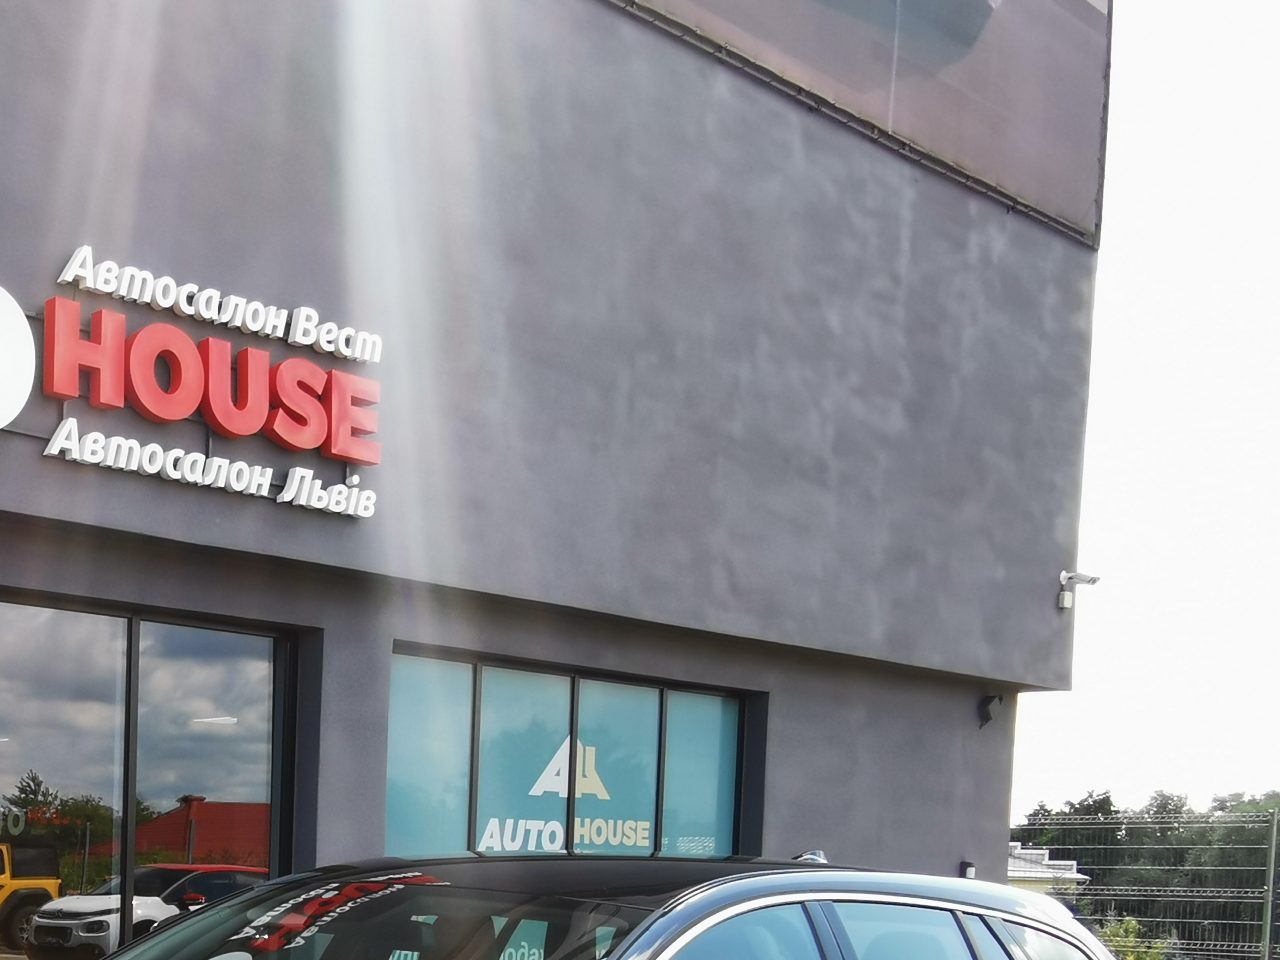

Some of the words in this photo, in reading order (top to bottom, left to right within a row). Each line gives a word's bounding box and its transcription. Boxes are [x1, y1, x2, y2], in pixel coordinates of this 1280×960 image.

[57, 245, 289, 338] Автосалон
[287, 307, 383, 363] Вест
[43, 296, 382, 466] HOUSE
[43, 417, 273, 497] Автосалон
[276, 467, 377, 519] Львів
[477, 818, 565, 851] AUTO
[574, 817, 650, 847] HOUSE
